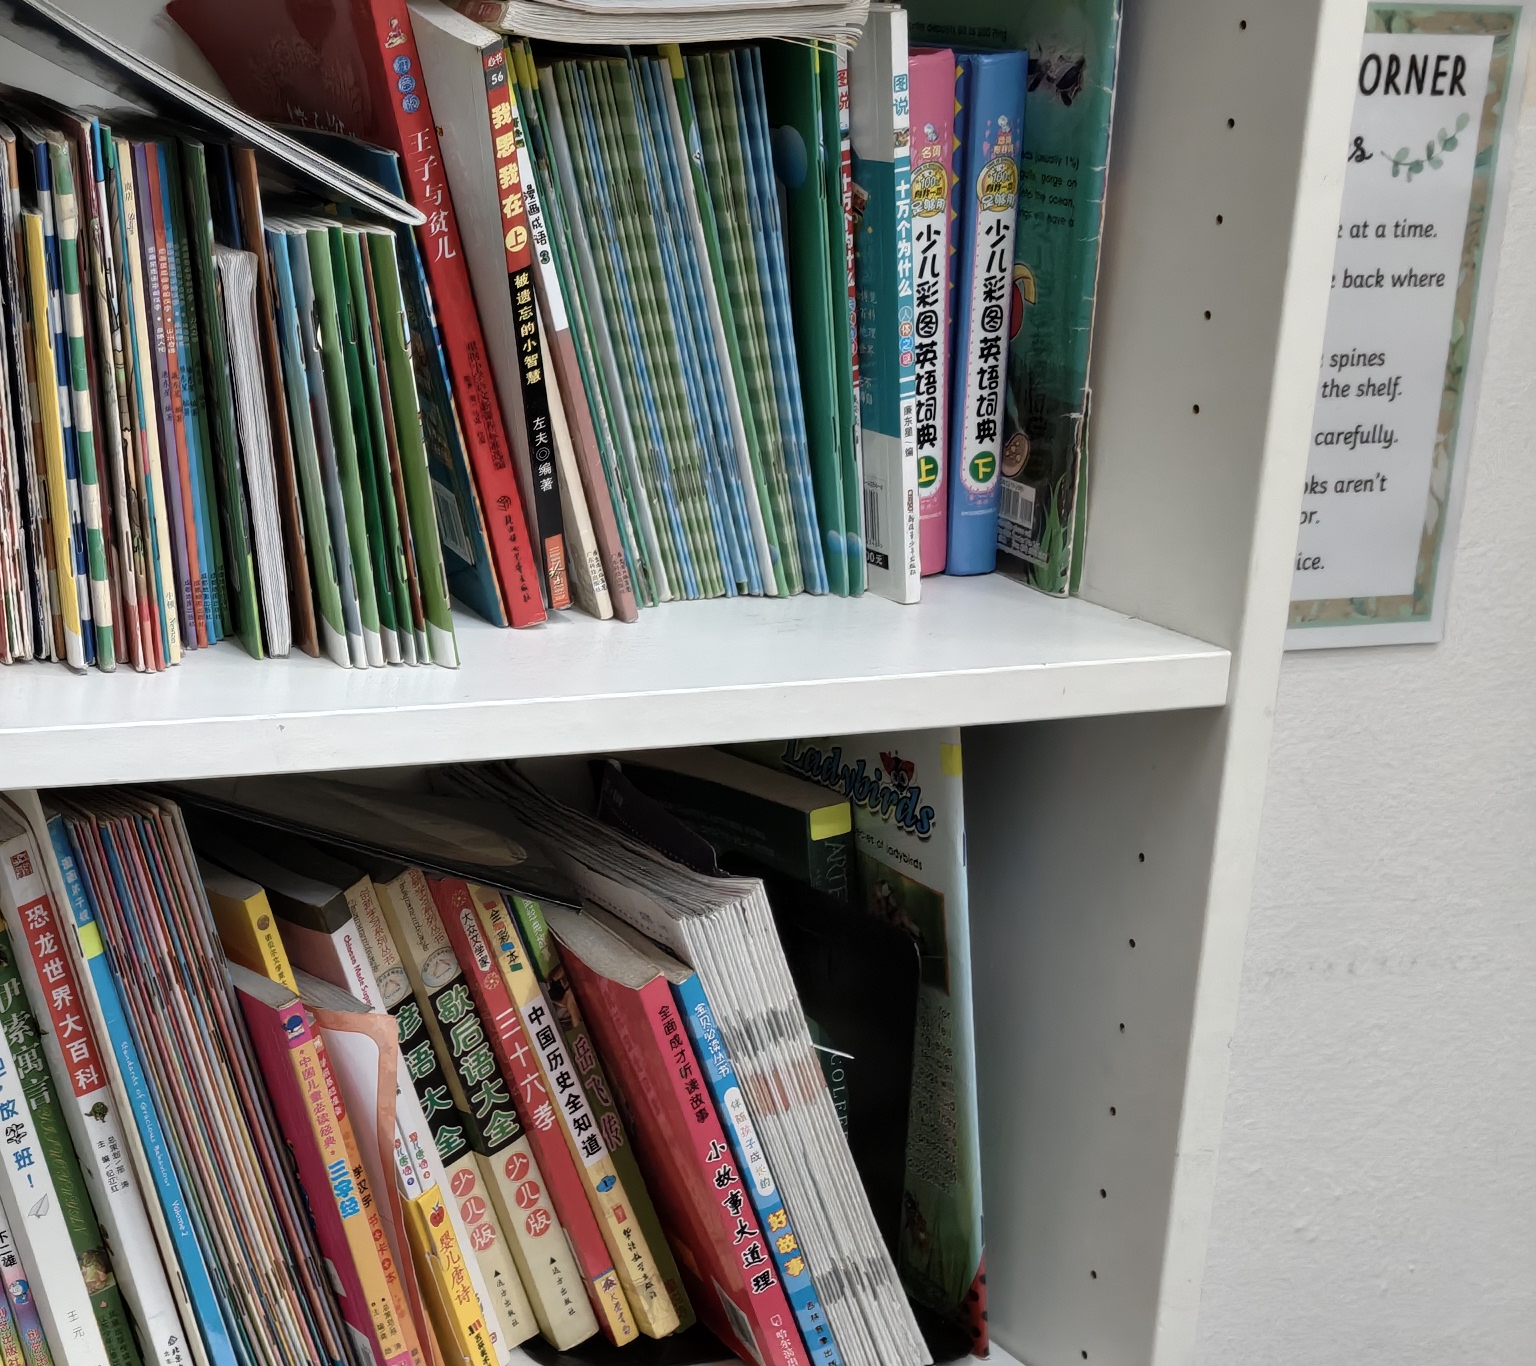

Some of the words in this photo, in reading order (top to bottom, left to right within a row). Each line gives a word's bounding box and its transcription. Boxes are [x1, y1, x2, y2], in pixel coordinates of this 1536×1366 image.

[407, 128, 458, 263] 王子与贫儿
[491, 105, 524, 219] 我思我在
[1342, 270, 1384, 289] back
[1391, 270, 1445, 289] where
[1349, 221, 1371, 239] at
[1375, 223, 1387, 239] a
[1393, 220, 1438, 239] time.
[513, 272, 542, 386] 被遗忘的小智慧
[914, 223, 940, 450] 少儿彩图英语词典
[974, 223, 1010, 444] 少儿彩图英语词典
[1322, 379, 1350, 398] the
[1356, 378, 1403, 400] shelf.
[1330, 350, 1385, 370] spines
[1314, 426, 1398, 448] carefully.
[23, 909, 103, 1091] 恐龙世界大百科
[433, 983, 521, 1145] 歇后语大全
[494, 1010, 555, 1135] 三十六孝
[527, 1005, 602, 1161] 中国历史全知道
[704, 1140, 776, 1295] 小故事大道理
